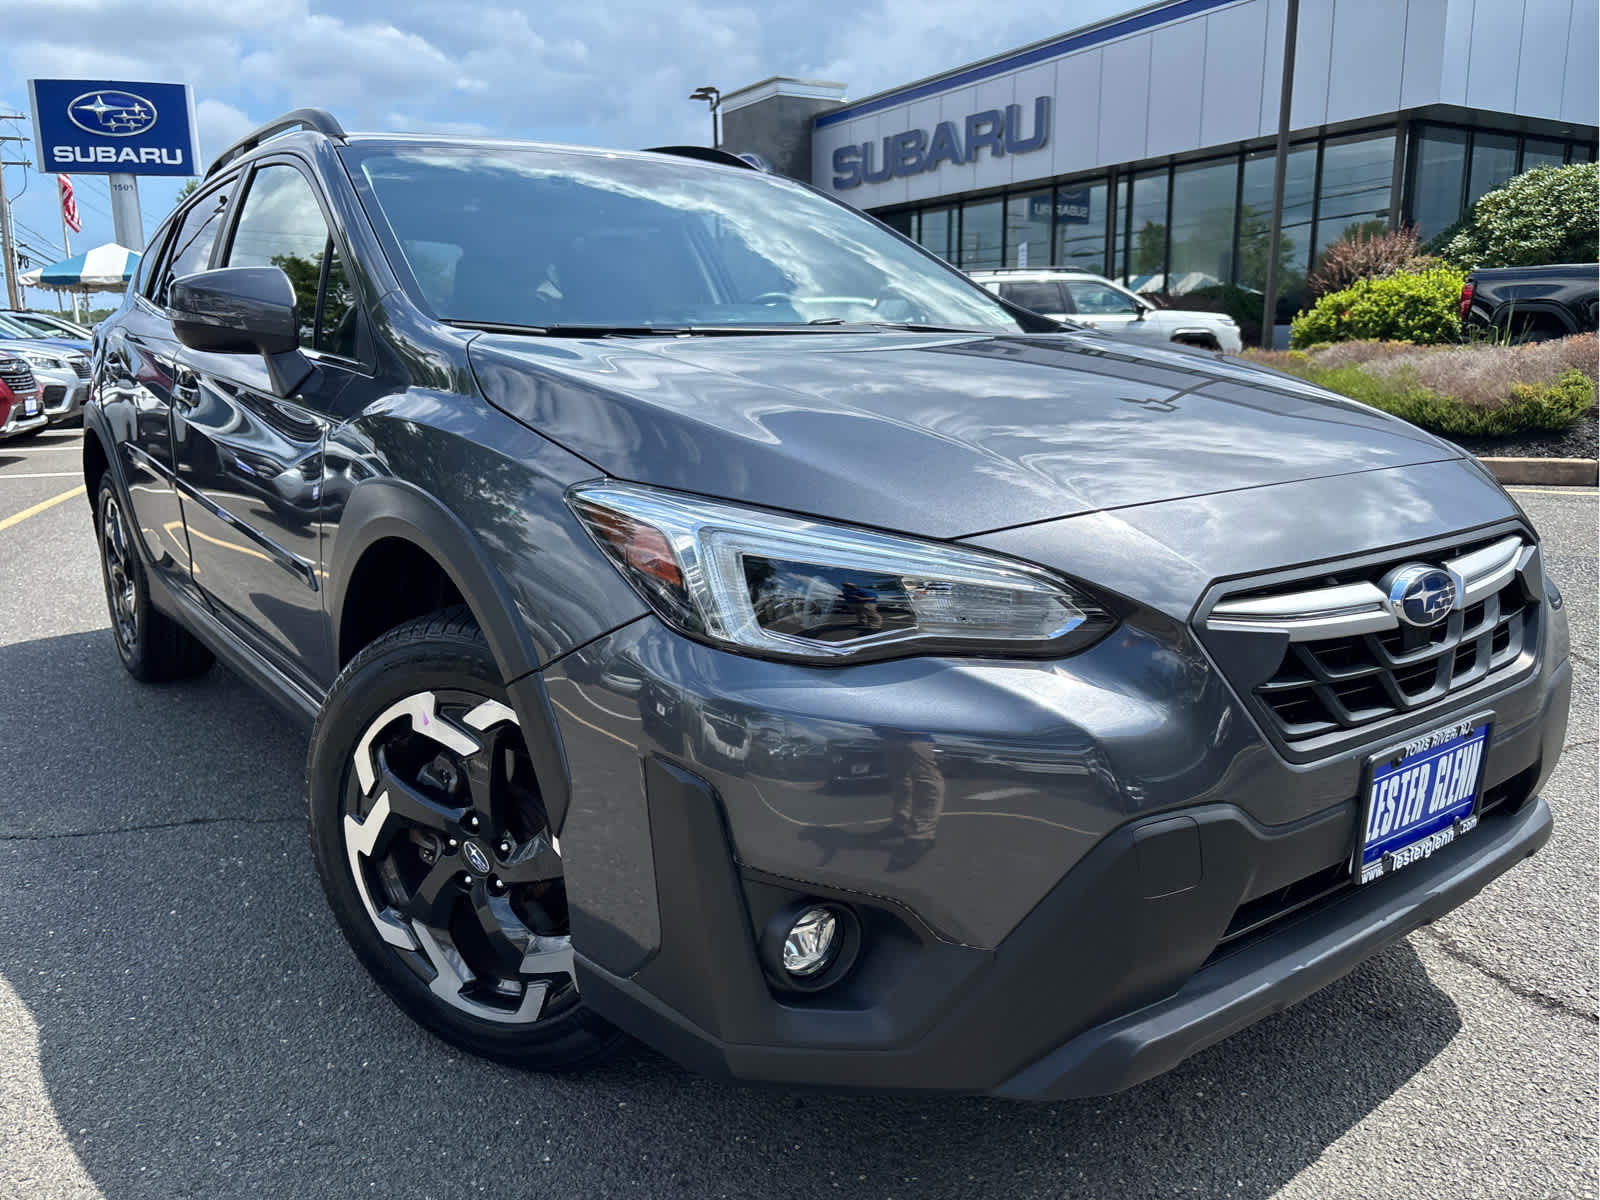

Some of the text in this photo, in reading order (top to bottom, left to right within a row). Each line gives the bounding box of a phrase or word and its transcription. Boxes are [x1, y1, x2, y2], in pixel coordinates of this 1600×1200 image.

[832, 95, 1052, 191] SUBARU
[52, 145, 184, 165] SUBARU
[113, 184, 134, 192] 1501
[1404, 736, 1433, 759] TOMS
[1365, 740, 1484, 843] LESTER GLENN
